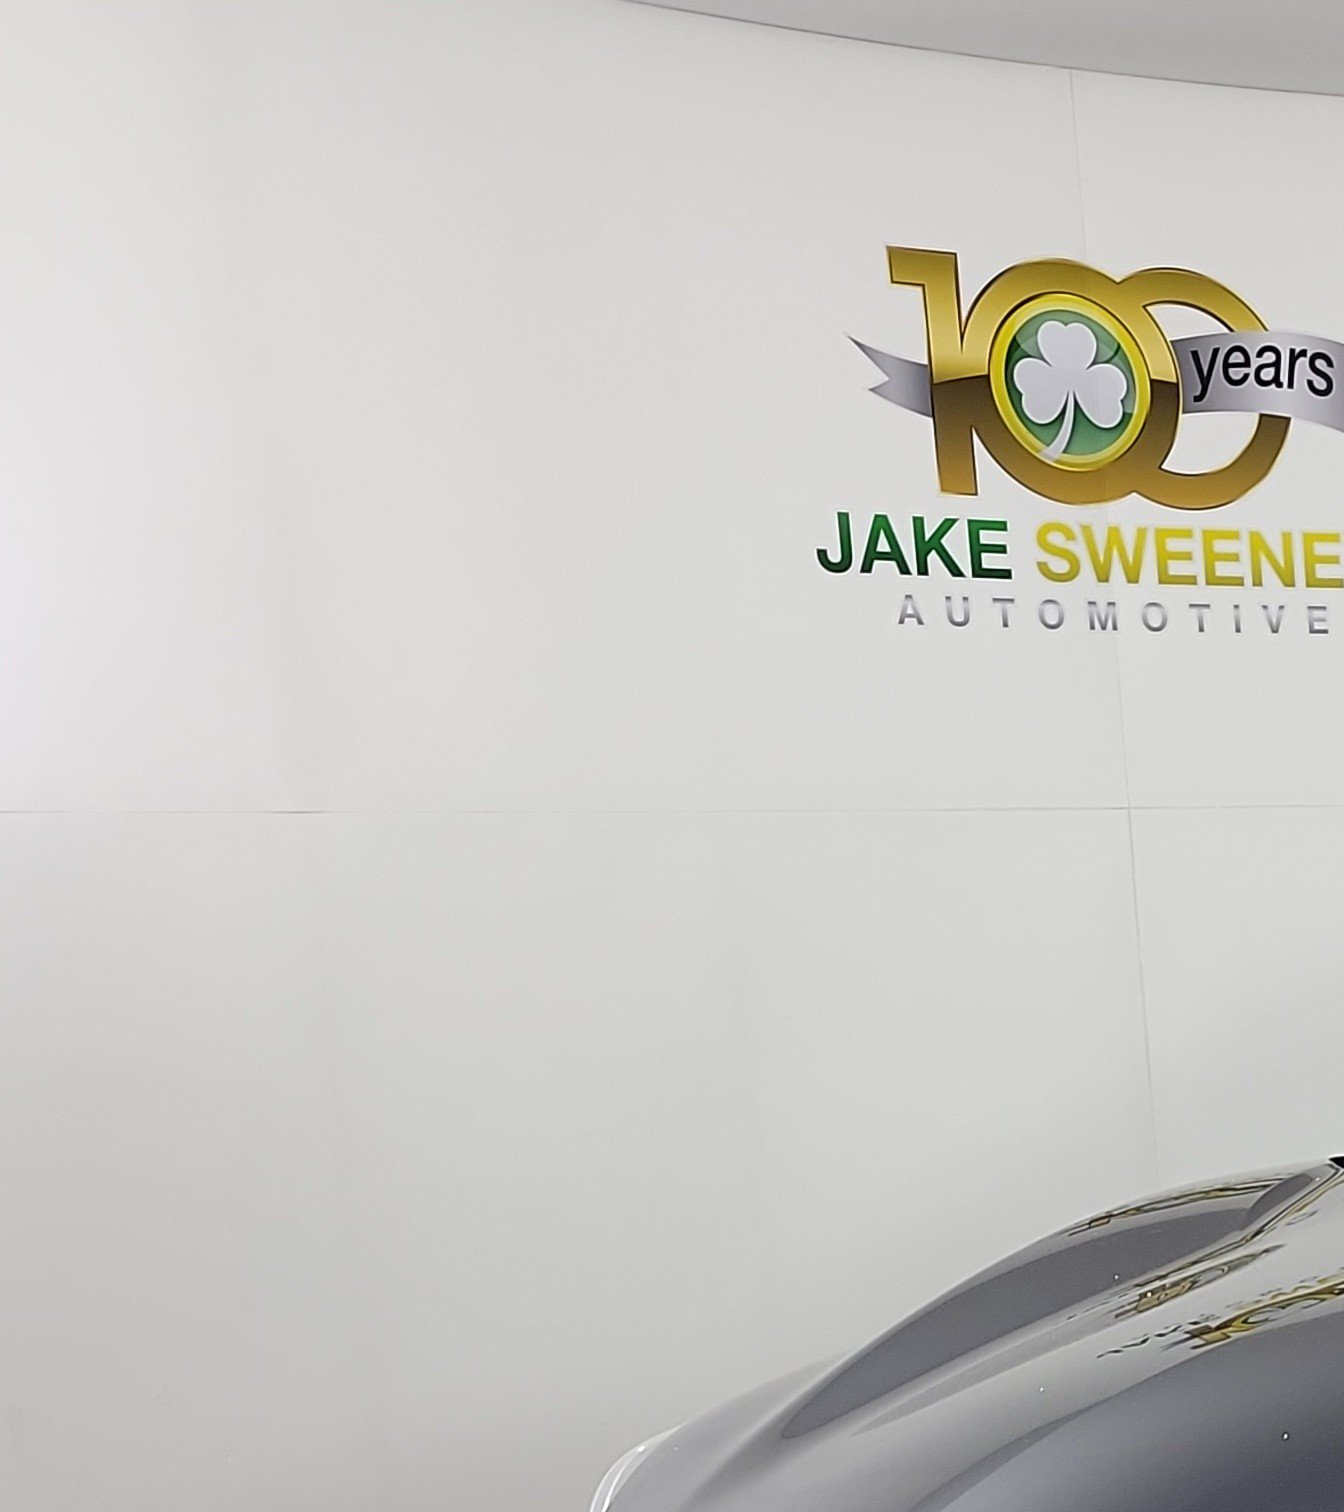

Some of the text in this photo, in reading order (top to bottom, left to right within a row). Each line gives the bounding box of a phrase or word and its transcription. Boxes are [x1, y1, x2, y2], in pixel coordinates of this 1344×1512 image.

[1190, 342, 1336, 403] years
[815, 510, 1014, 580] JAKE
[897, 593, 1330, 635] AUTOMOTIVE
